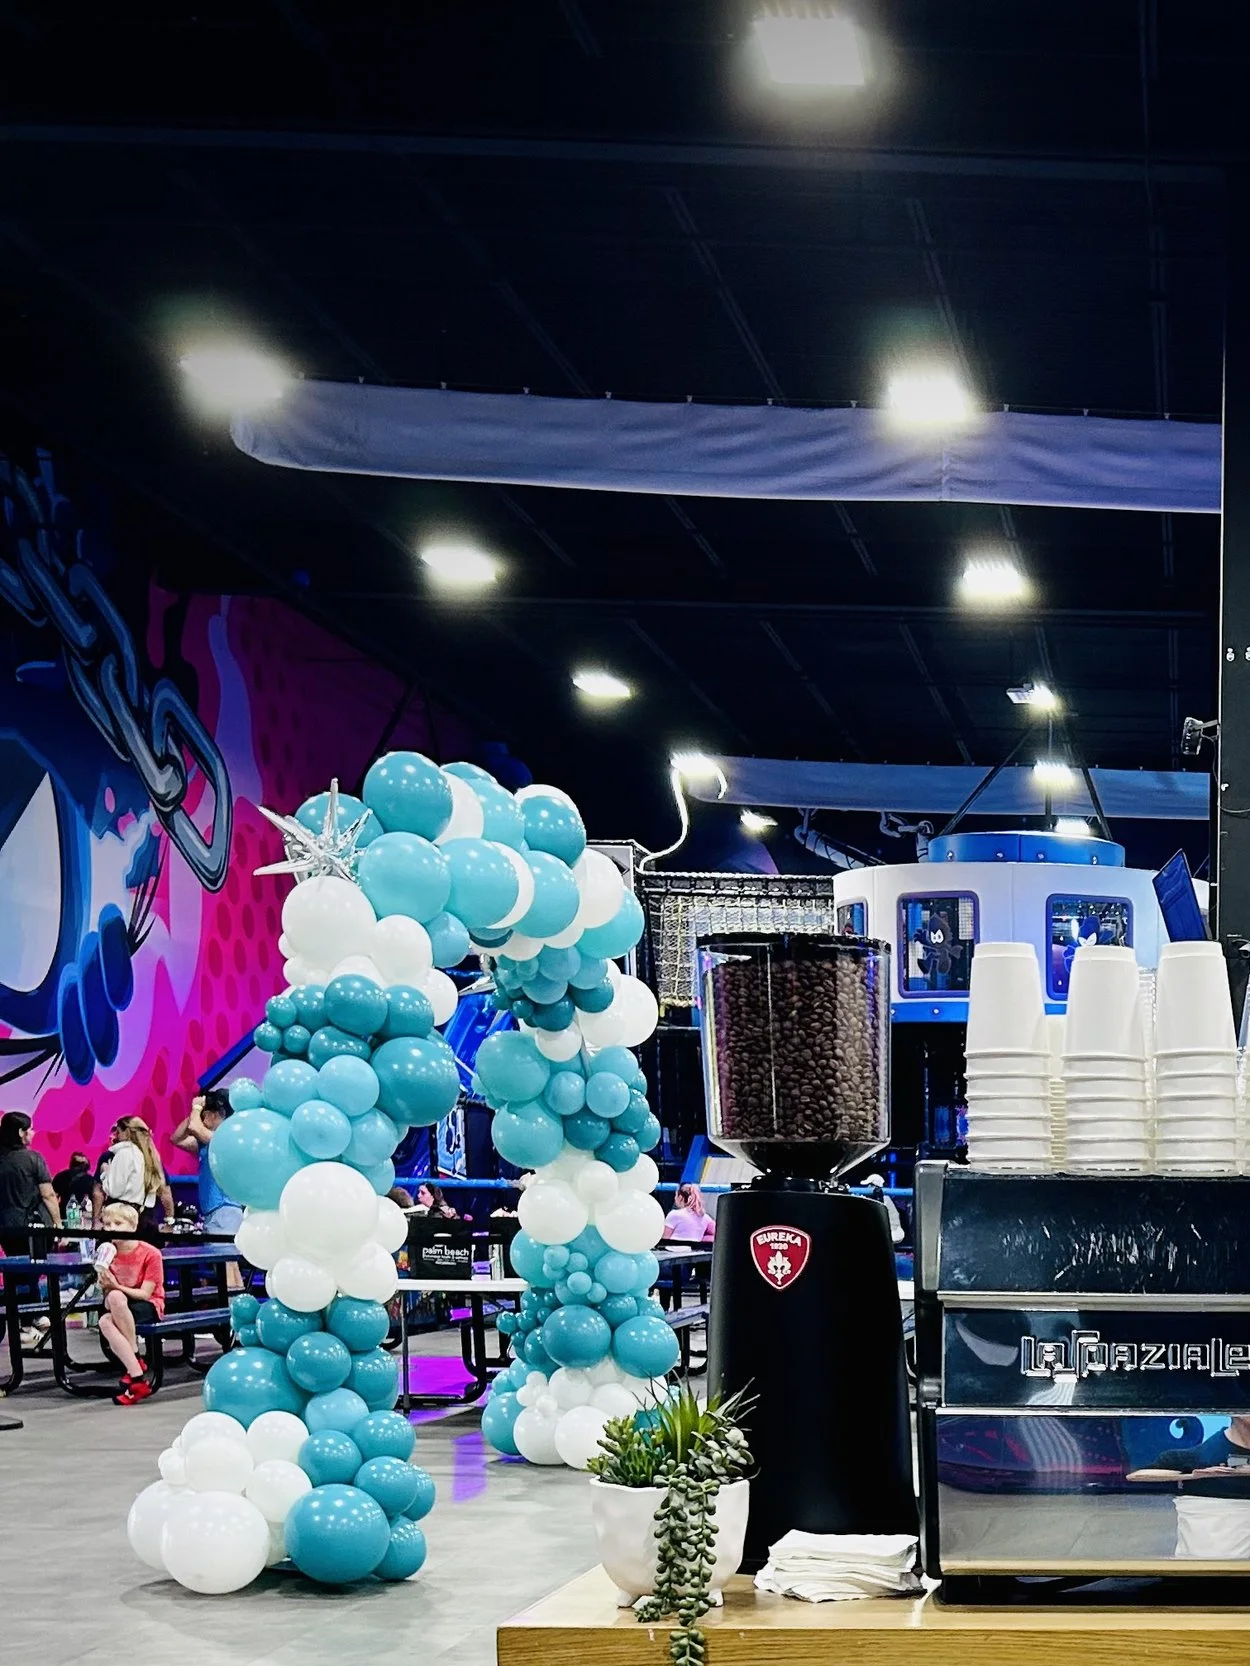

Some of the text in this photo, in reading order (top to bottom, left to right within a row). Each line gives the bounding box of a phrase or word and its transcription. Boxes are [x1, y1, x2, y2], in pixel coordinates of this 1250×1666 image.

[756, 1232, 802, 1247] EUREKA
[422, 1245, 469, 1259] palm beach
